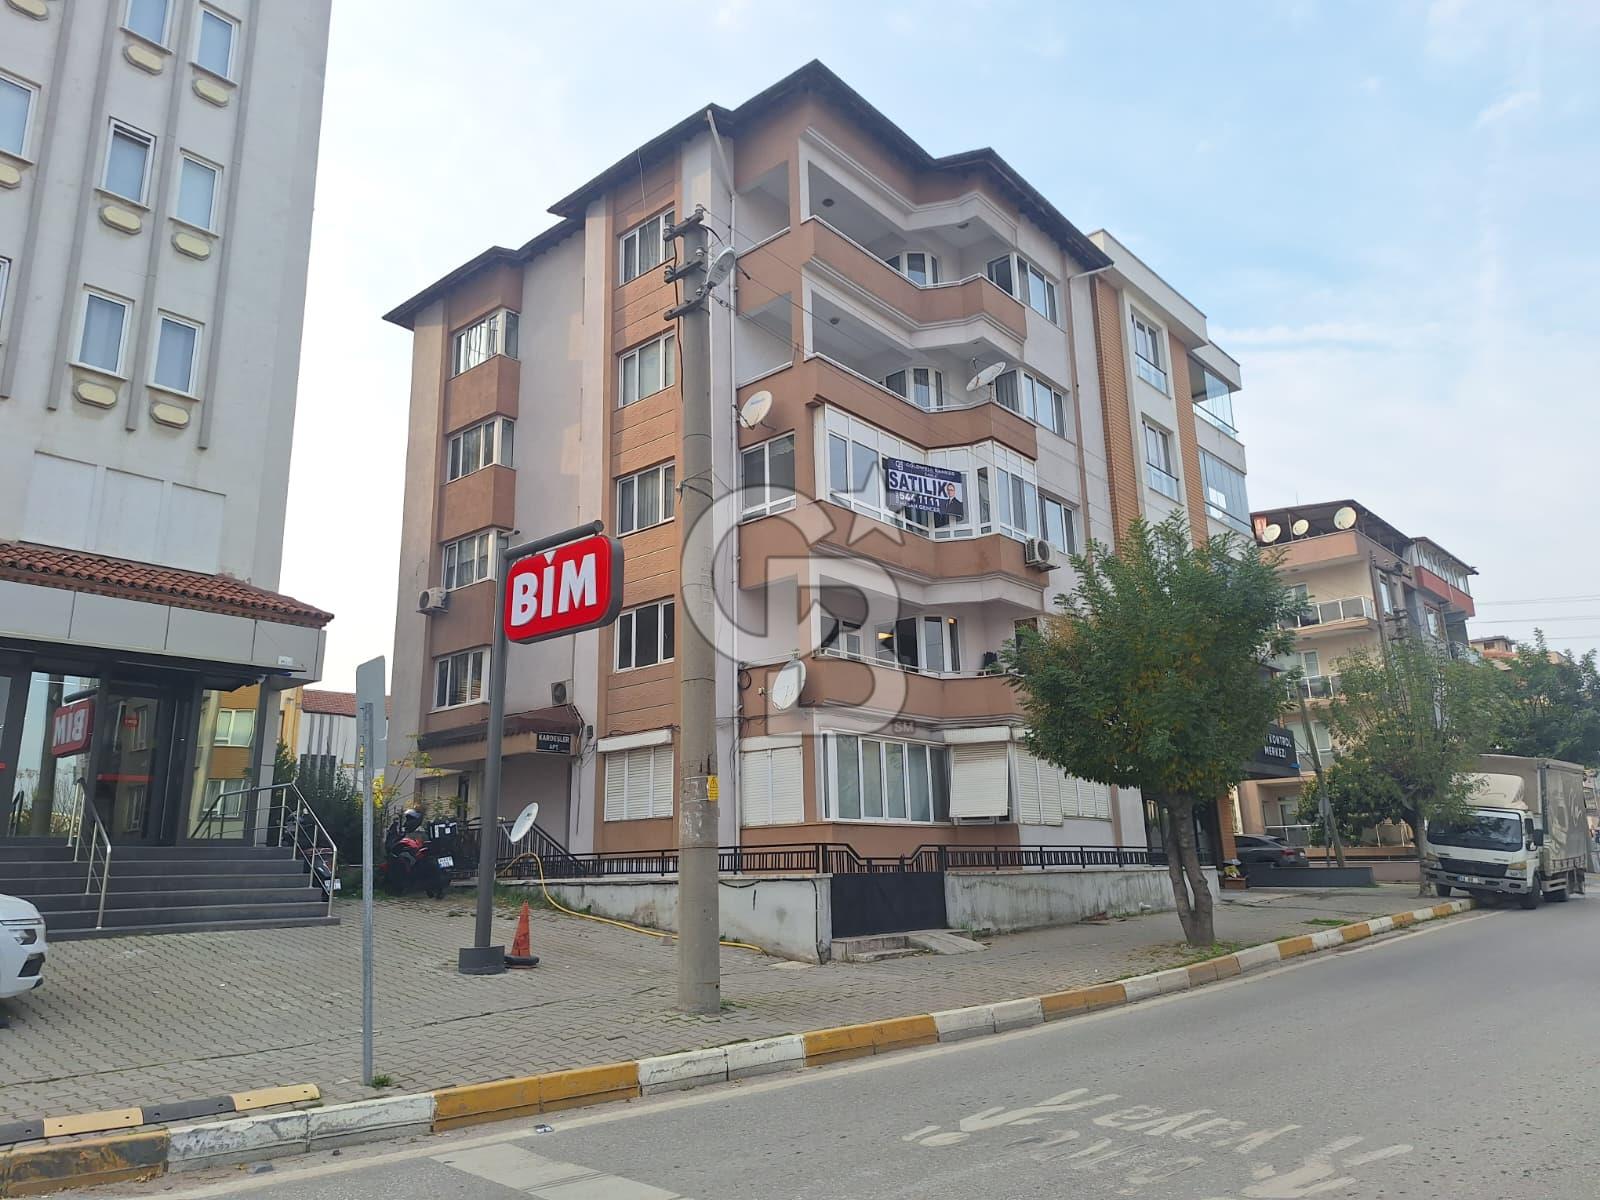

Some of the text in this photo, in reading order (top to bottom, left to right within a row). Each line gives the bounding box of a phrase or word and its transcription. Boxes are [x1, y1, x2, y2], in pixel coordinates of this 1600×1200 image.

[889, 471, 949, 498] SATILIK
[918, 495, 940, 507] 1111
[510, 550, 597, 626] BİM
